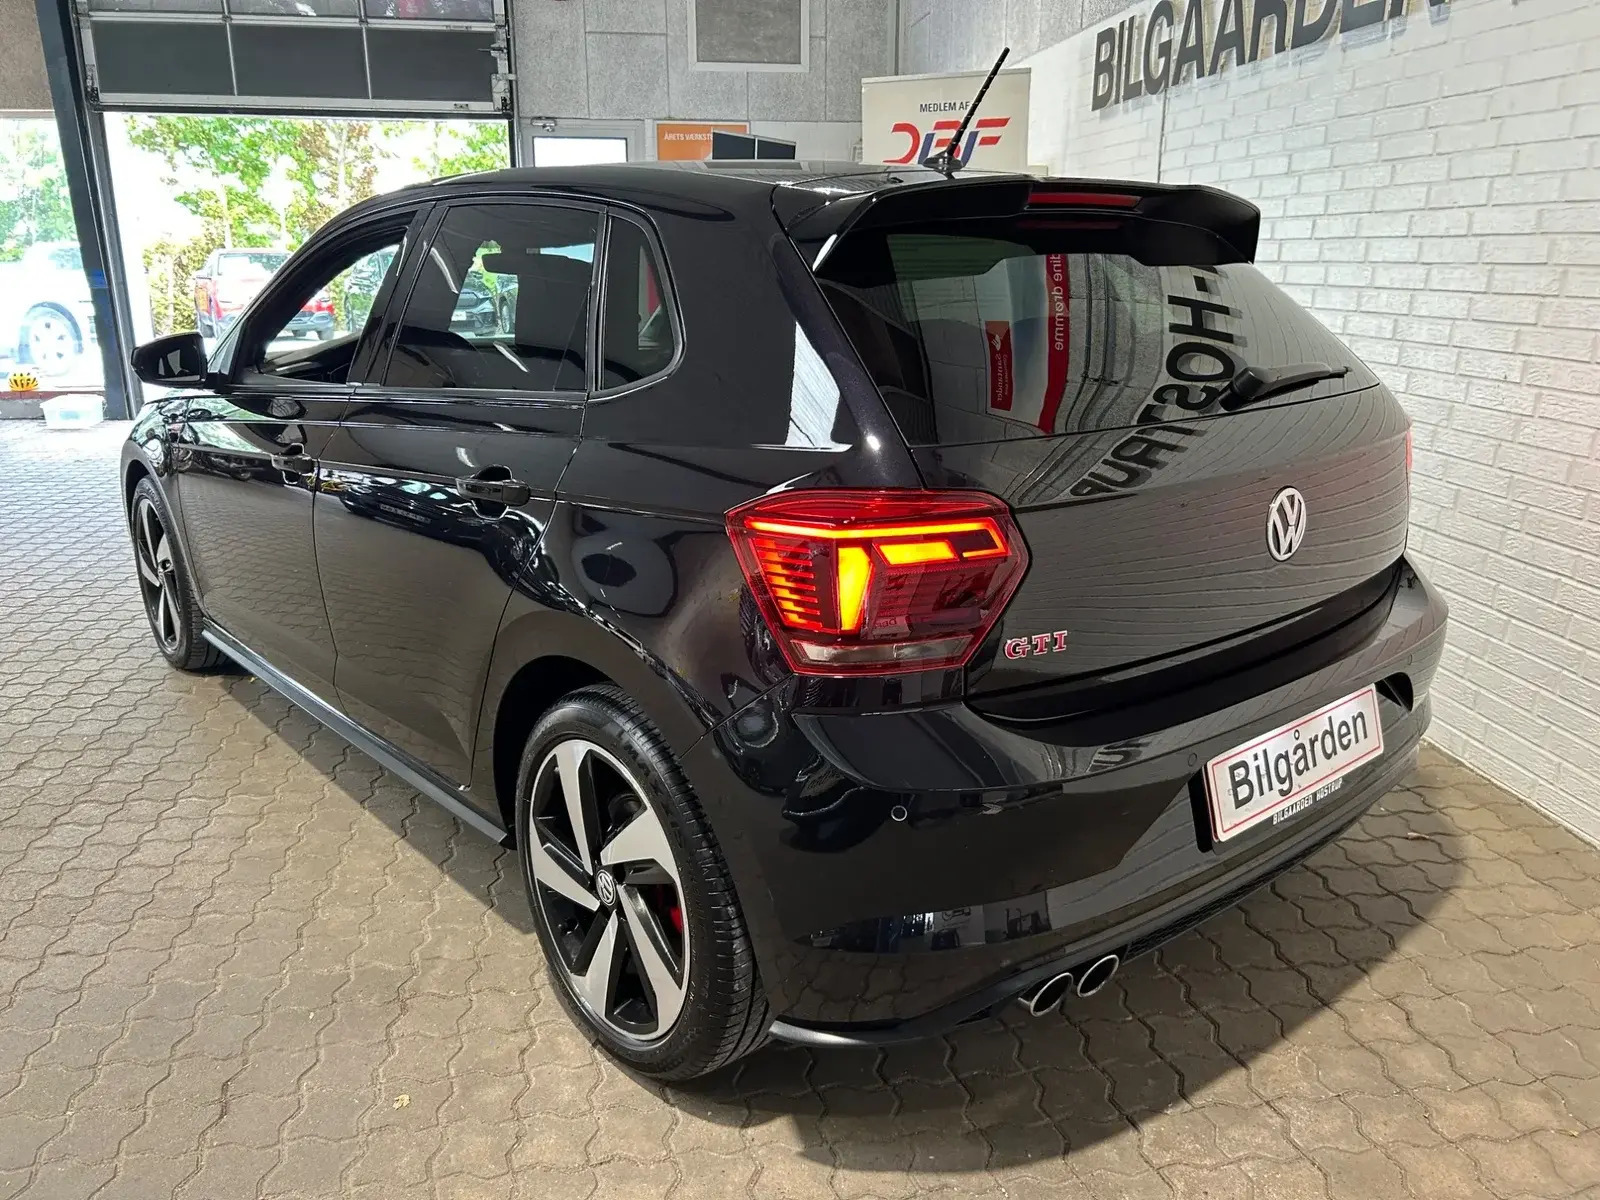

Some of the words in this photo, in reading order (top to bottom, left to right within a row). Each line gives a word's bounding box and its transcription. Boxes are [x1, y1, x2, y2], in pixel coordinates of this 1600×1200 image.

[919, 102, 957, 113] MEDLEM
[958, 101, 970, 111] AF
[1004, 630, 1067, 660] GTI
[1228, 711, 1368, 810] Bilgården
